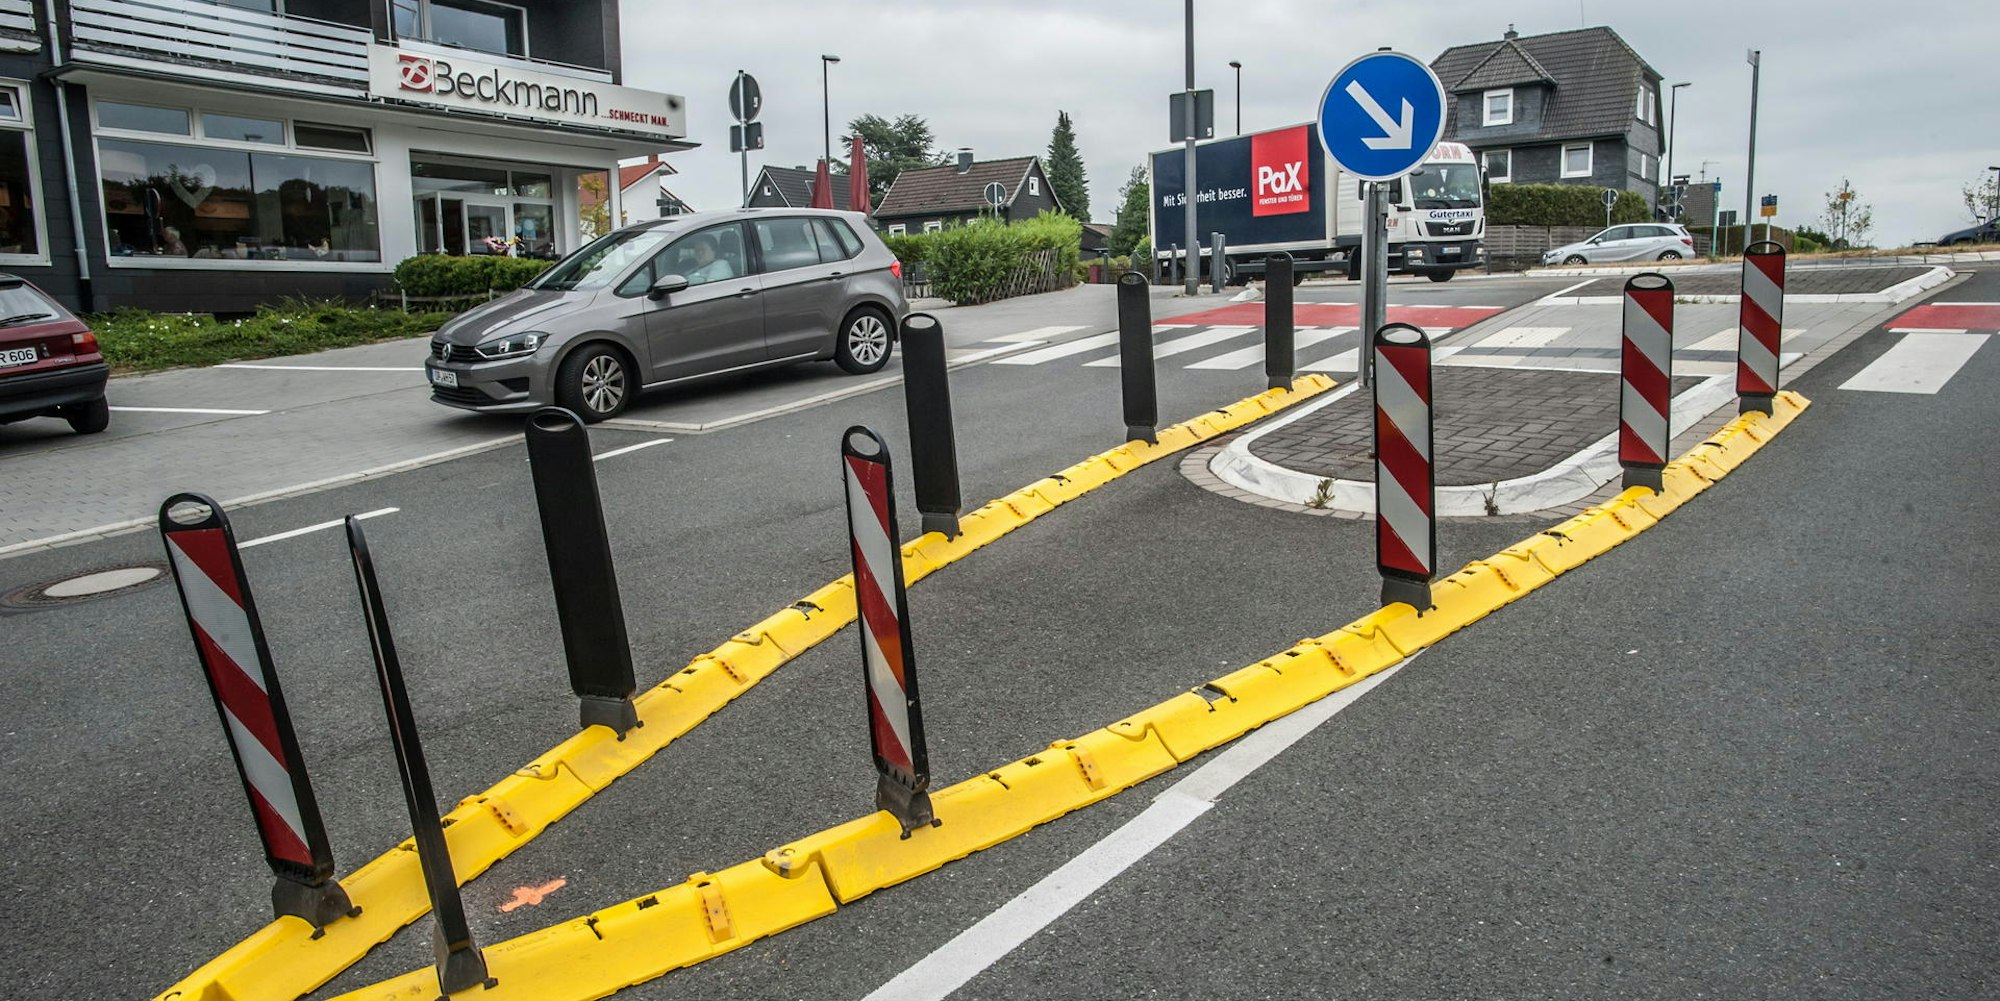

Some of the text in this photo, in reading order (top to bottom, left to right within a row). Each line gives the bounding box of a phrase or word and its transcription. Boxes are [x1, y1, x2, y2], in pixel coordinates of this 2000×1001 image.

[435, 59, 599, 117] Beckmann
[1258, 161, 1302, 196] PaX
[1163, 188, 1247, 207] Mit Sicrheit besser.
[9, 349, 34, 362] 606
